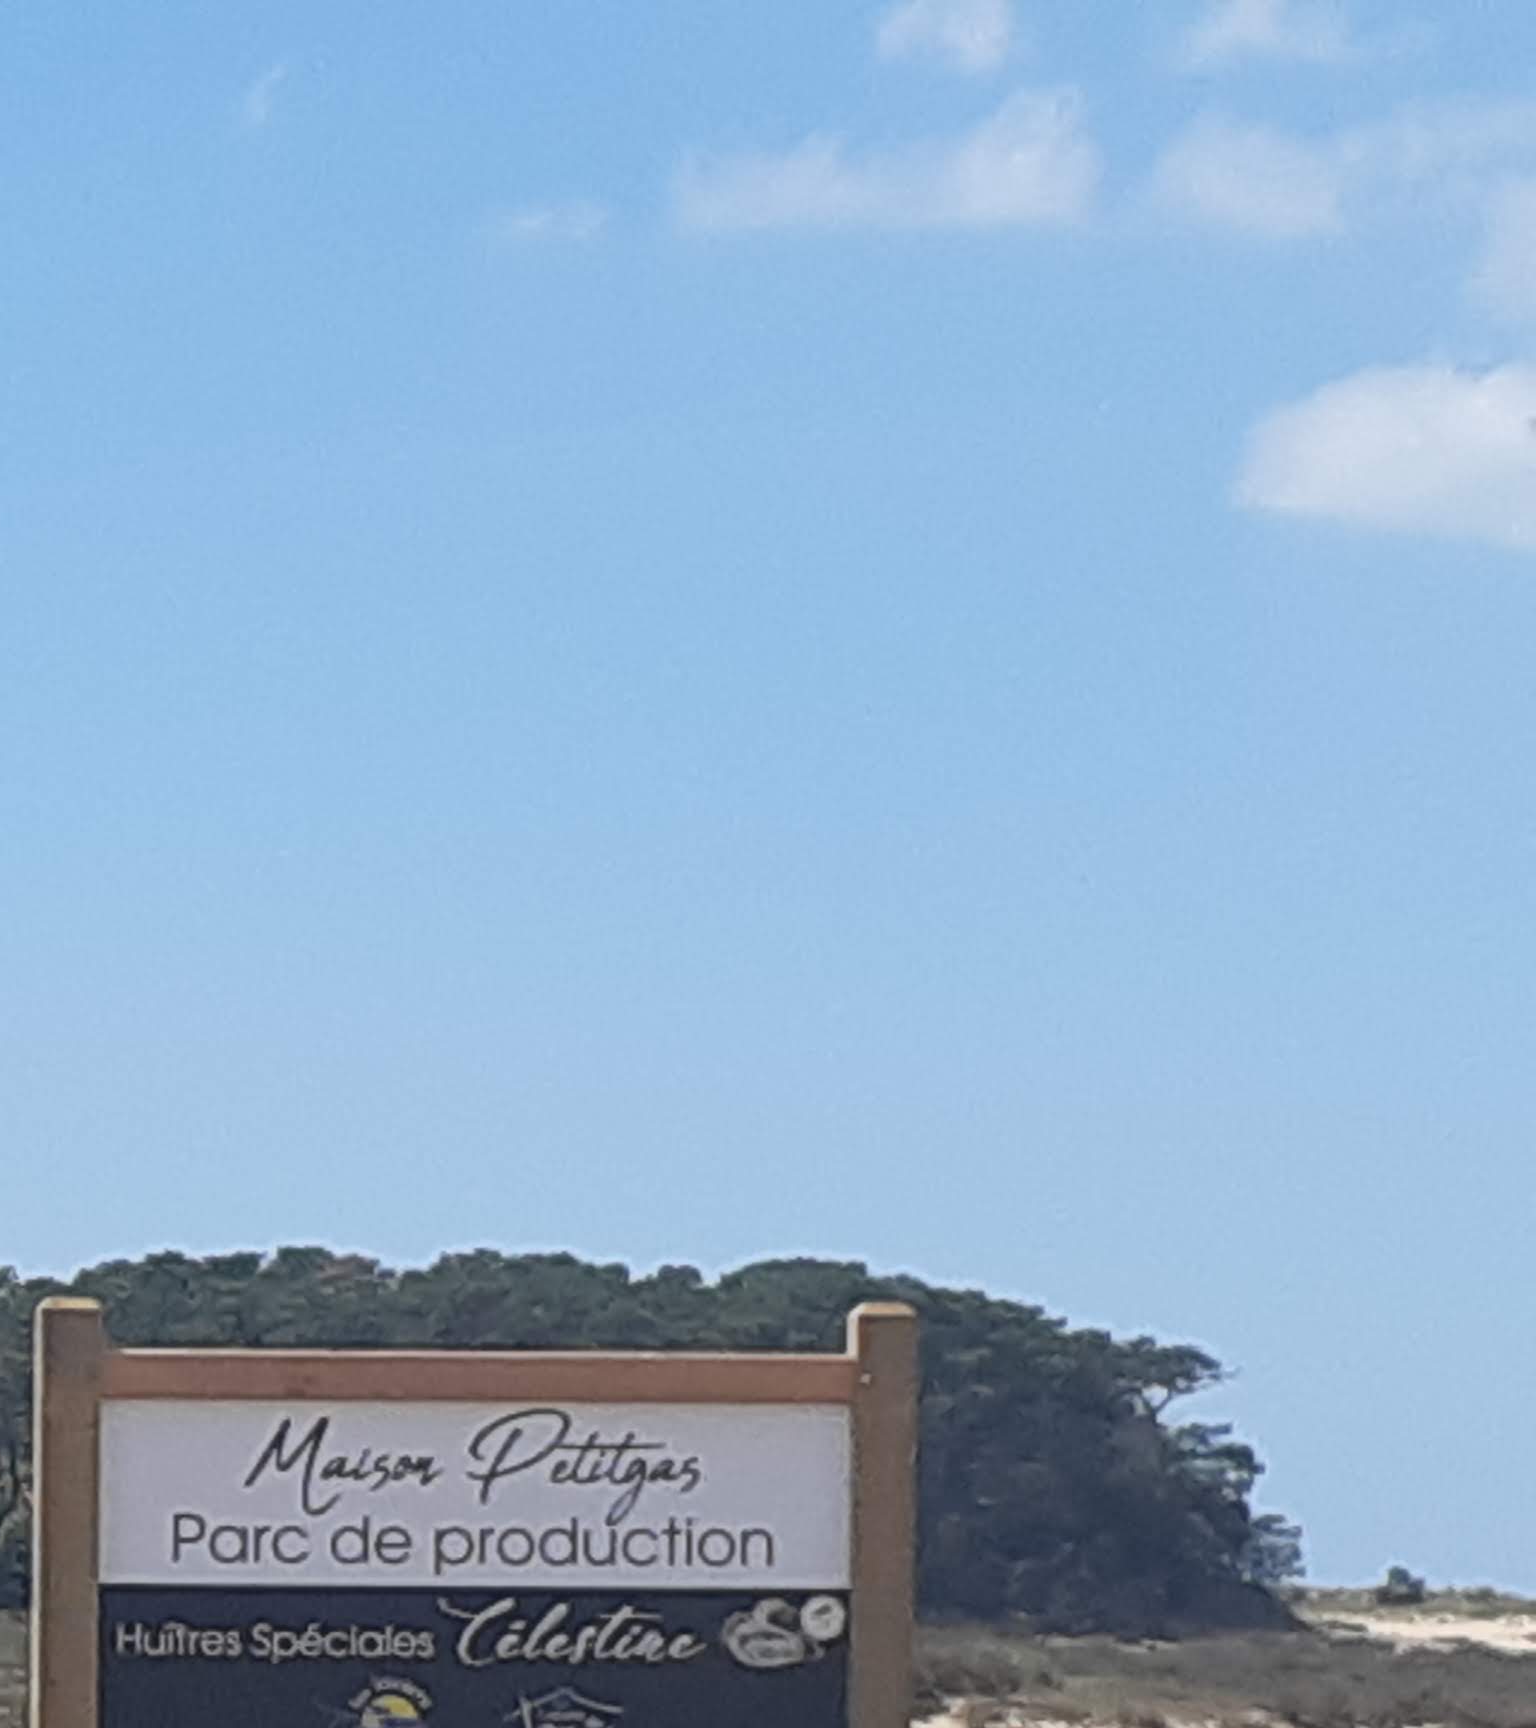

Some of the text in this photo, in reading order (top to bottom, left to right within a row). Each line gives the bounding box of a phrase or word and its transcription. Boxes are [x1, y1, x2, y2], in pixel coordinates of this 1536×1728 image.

[245, 1408, 704, 1528] Maison Petitgas
[172, 1513, 776, 1576] Parc de production
[117, 1596, 707, 1667] Huîtres Spéciales Célestine
